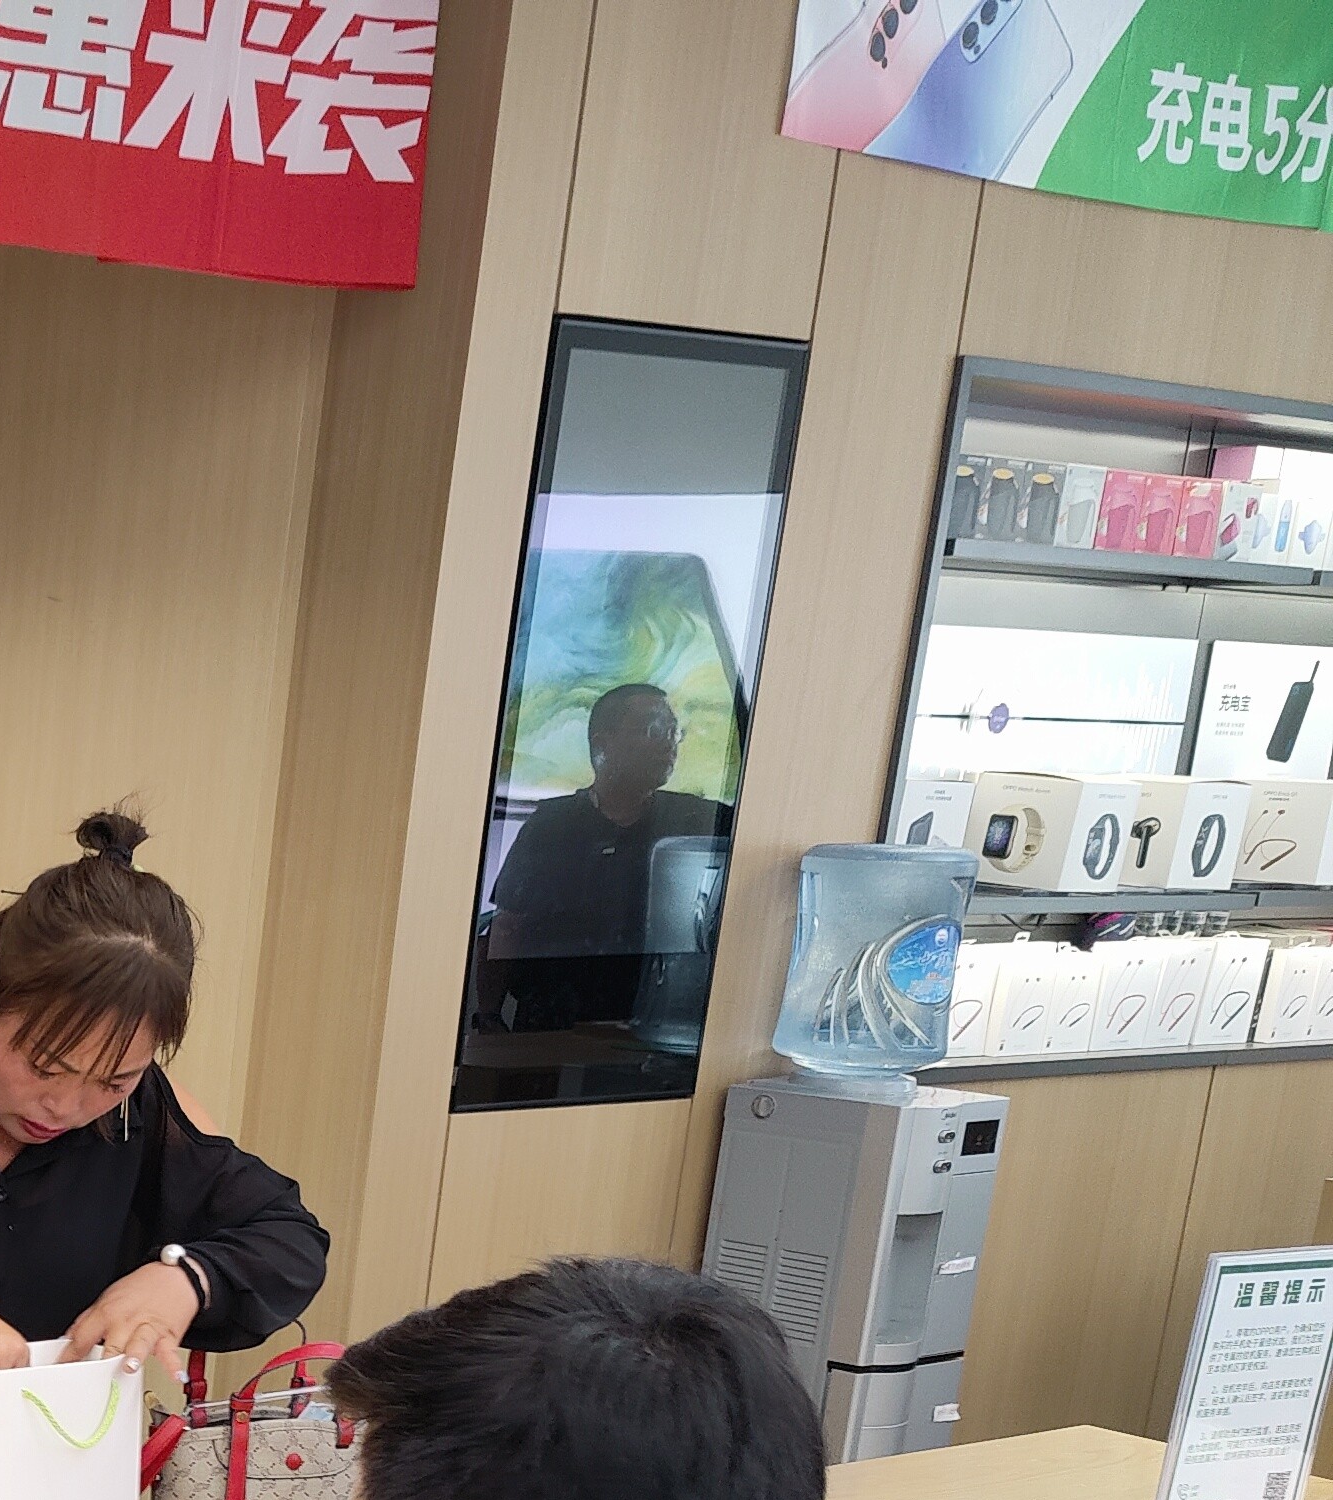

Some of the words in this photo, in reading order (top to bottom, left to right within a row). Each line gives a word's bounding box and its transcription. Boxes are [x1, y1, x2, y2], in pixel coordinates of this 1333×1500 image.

[1136, 62, 1333, 184] 充电5分
[1233, 1278, 1327, 1309] 温馨提示
